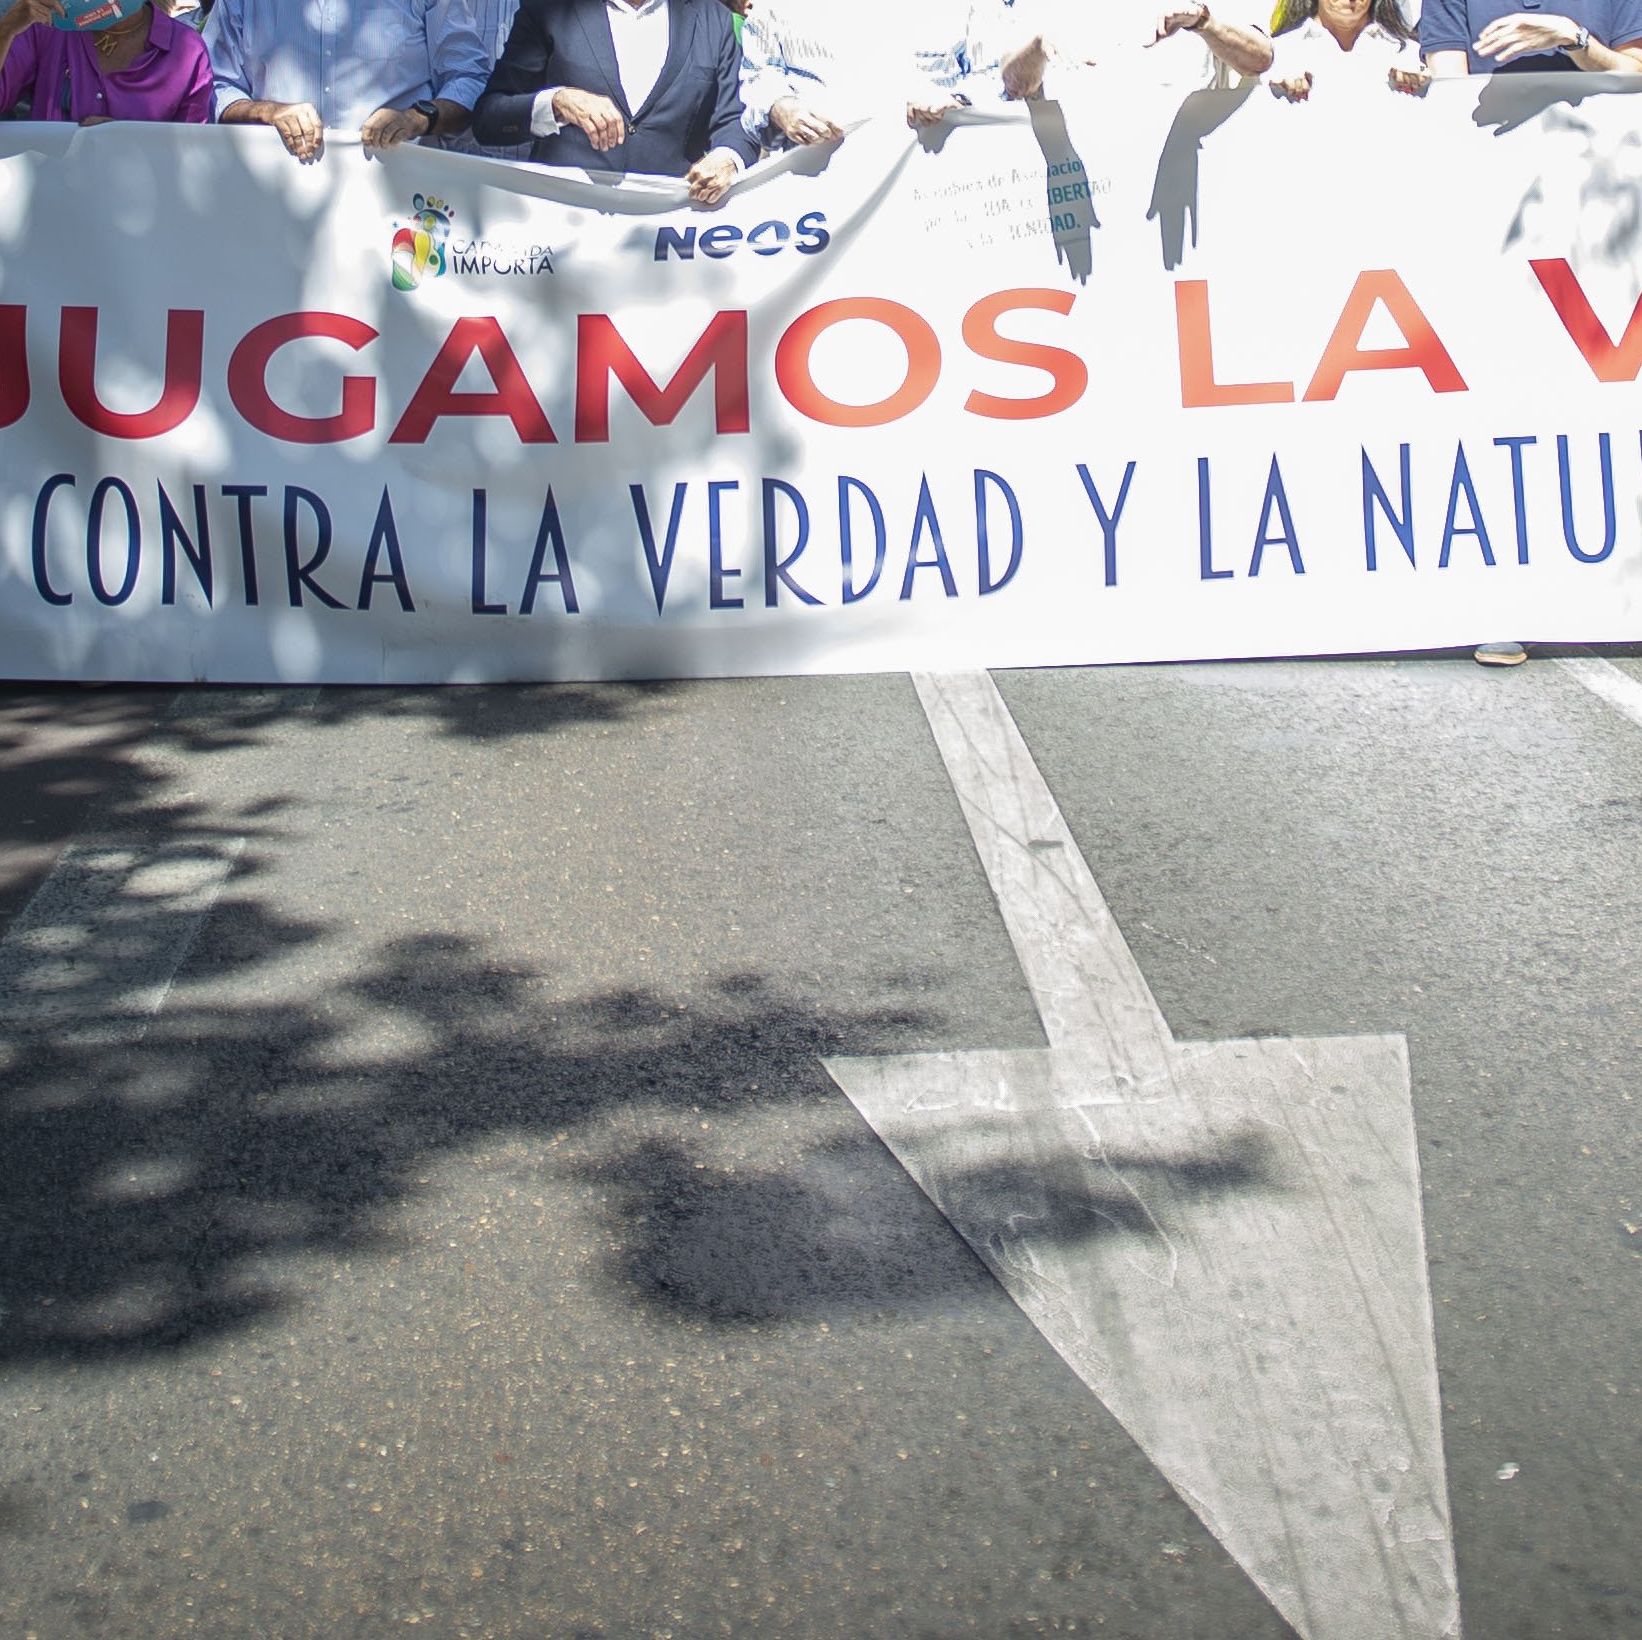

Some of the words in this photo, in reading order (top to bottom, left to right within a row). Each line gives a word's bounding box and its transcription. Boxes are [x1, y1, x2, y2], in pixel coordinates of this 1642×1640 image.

[452, 255, 555, 276] IMPORTA
[1174, 268, 1470, 409] LA
[30, 473, 417, 614] CONTRA
[471, 483, 581, 616] LA
[628, 467, 1025, 618] VERDAD
[1075, 460, 1138, 588] Y
[1196, 451, 1307, 583] LA
